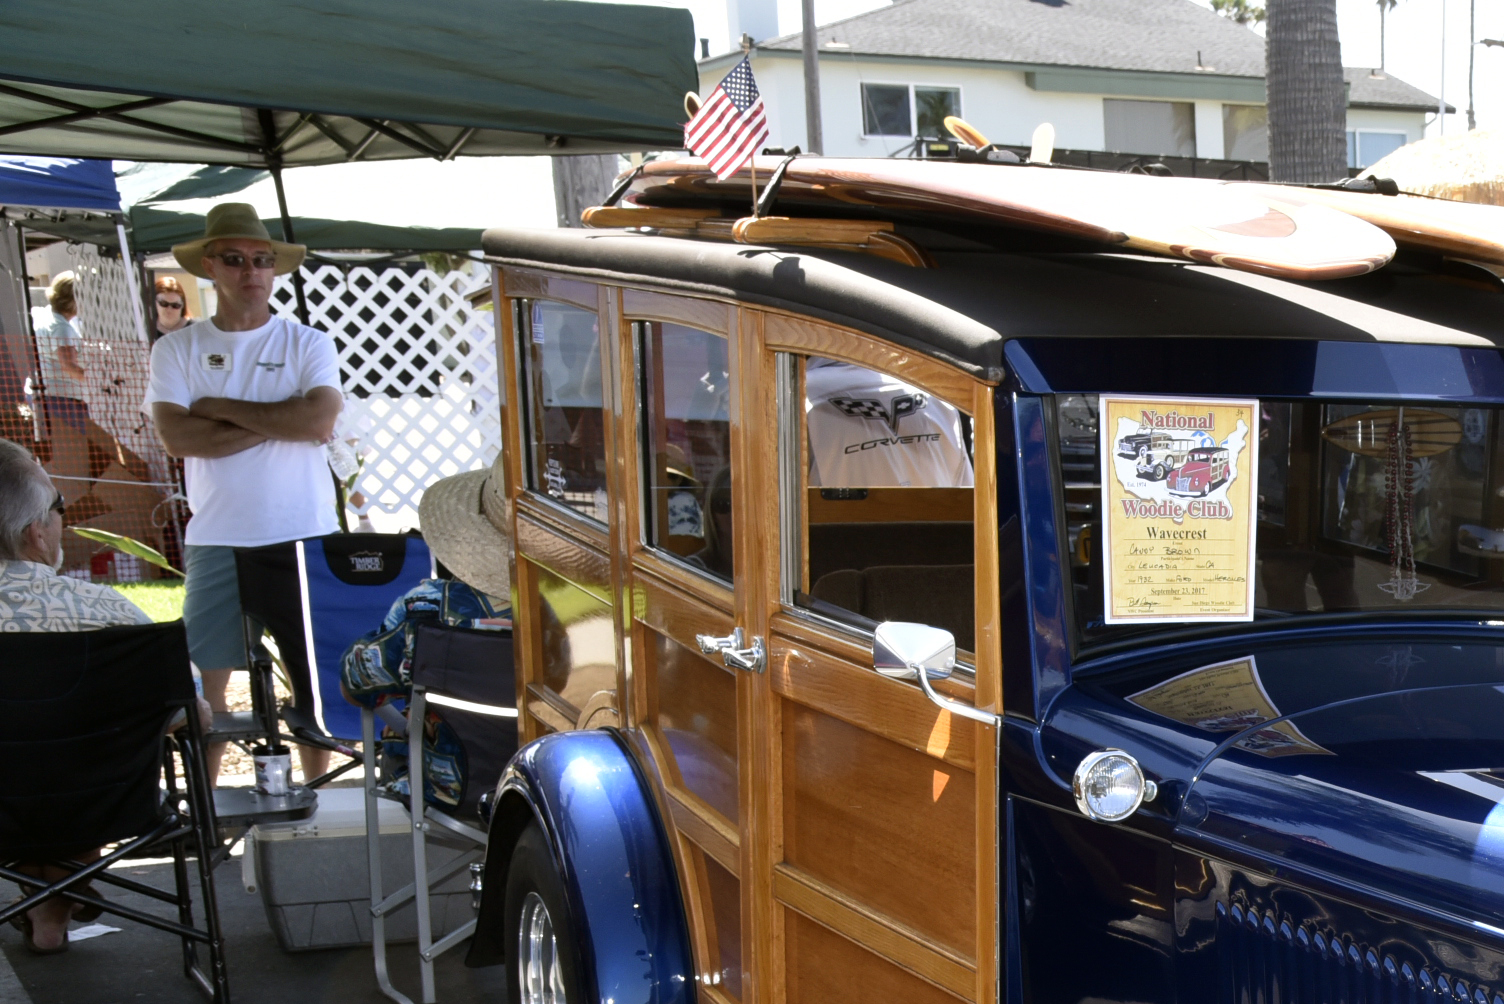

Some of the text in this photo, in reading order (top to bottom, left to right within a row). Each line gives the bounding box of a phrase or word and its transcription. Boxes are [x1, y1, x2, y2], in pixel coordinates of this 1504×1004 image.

[1140, 410, 1214, 430] National
[845, 433, 941, 454] CORVETTE
[1121, 499, 1229, 517] Woodie Club
[1146, 526, 1207, 539] Wavecrest
